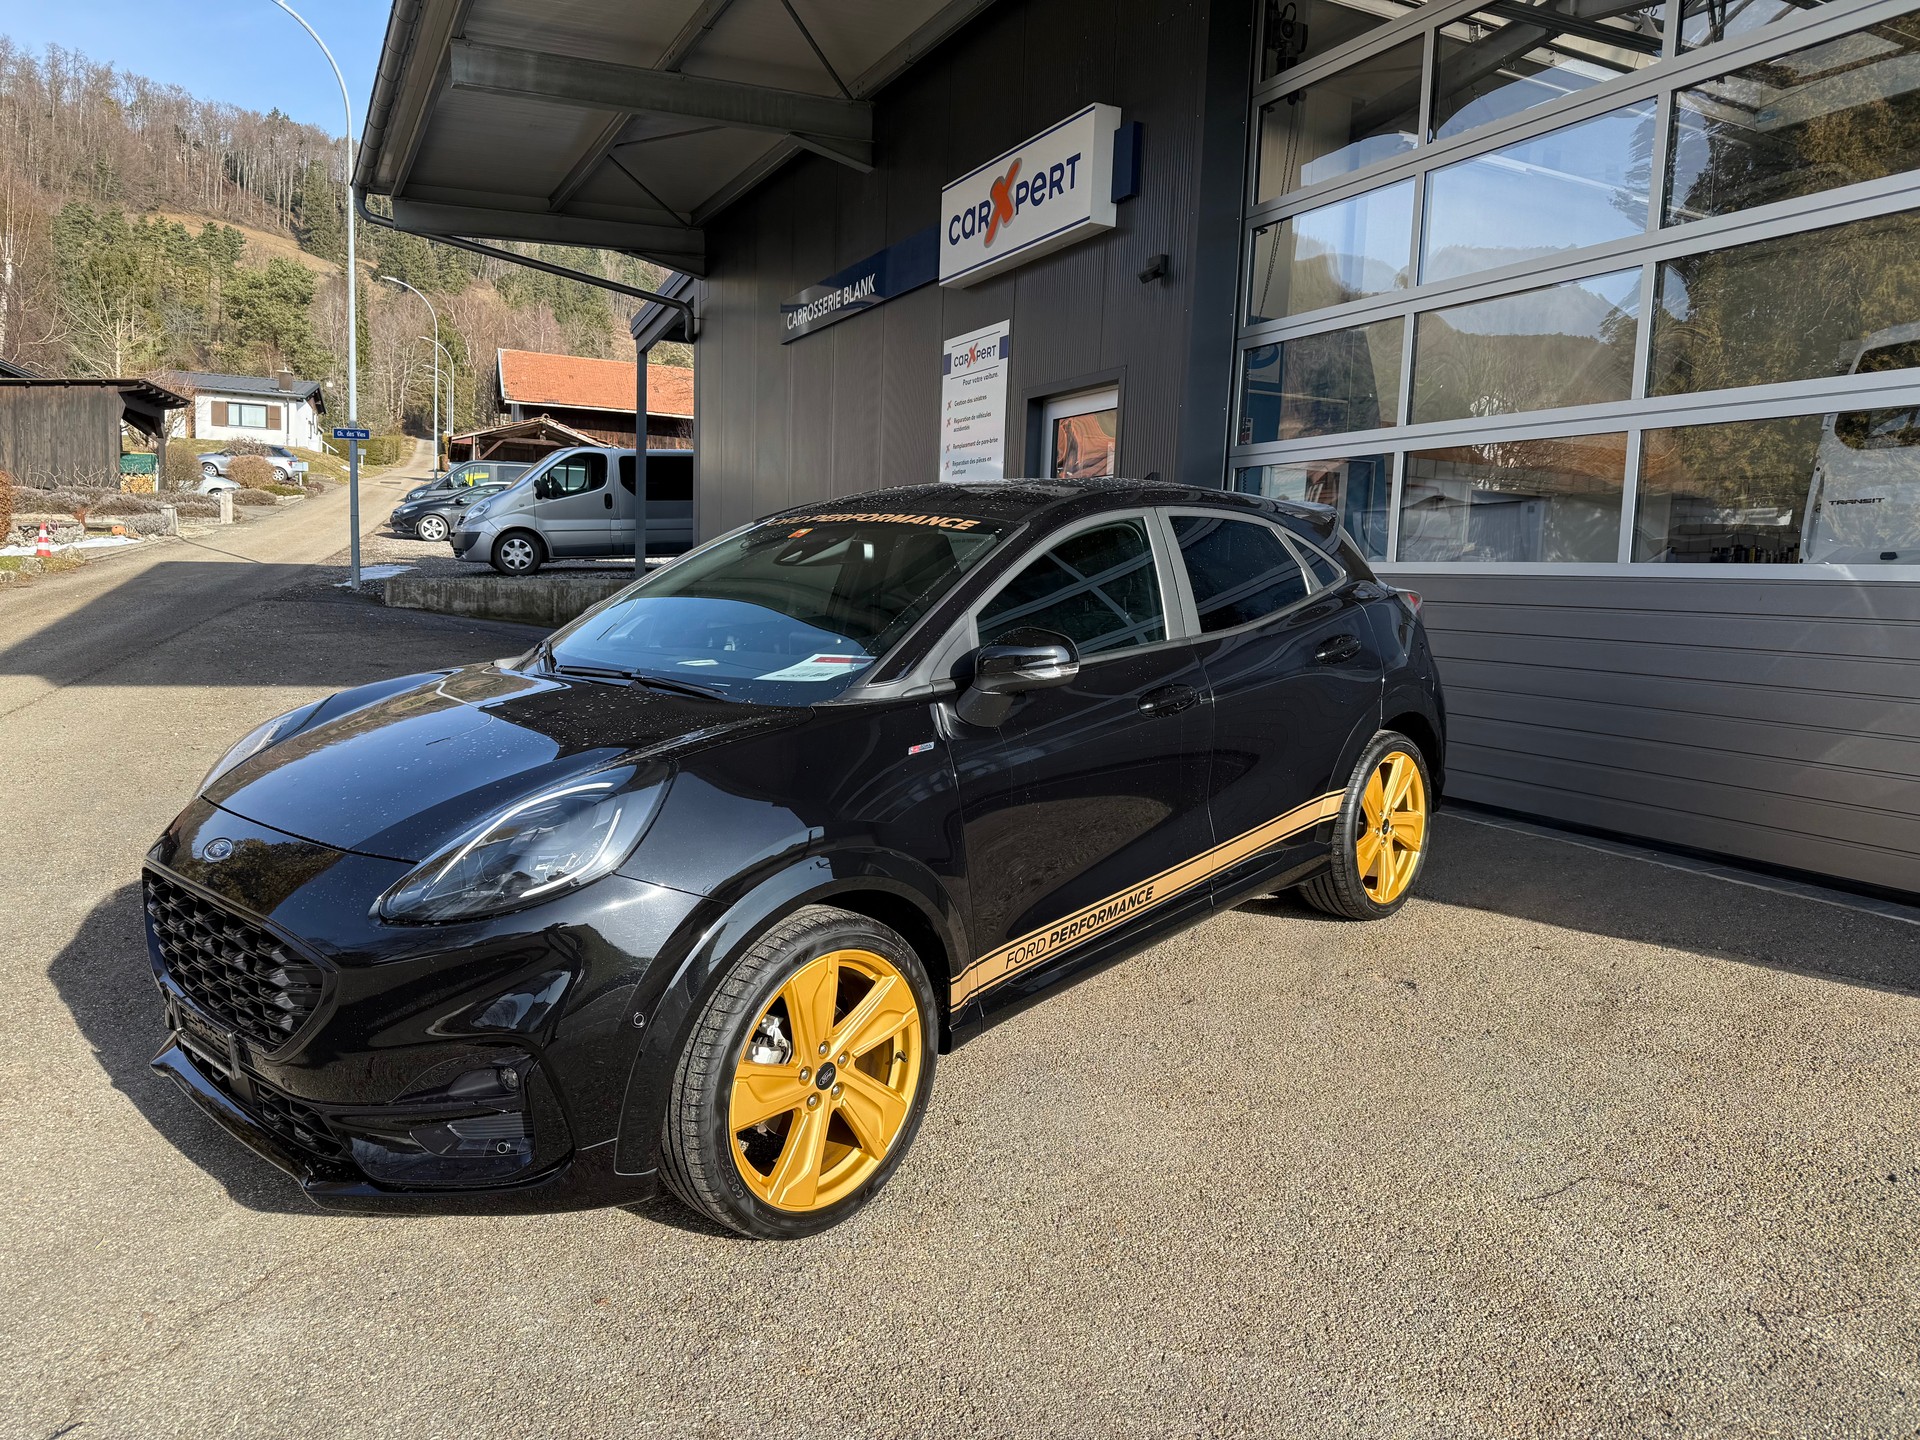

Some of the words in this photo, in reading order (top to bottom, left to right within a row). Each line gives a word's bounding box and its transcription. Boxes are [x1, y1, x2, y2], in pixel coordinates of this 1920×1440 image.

[787, 289, 841, 330] CARROSSERIE
[843, 273, 876, 306] BLANK
[963, 378, 972, 386] Pour
[973, 376, 983, 384] votre
[1828, 497, 1885, 506] TRANSIT
[804, 513, 982, 531] PERFORMANCE
[1005, 937, 1047, 970] FORD
[1048, 885, 1154, 949] PERFORMANCE
